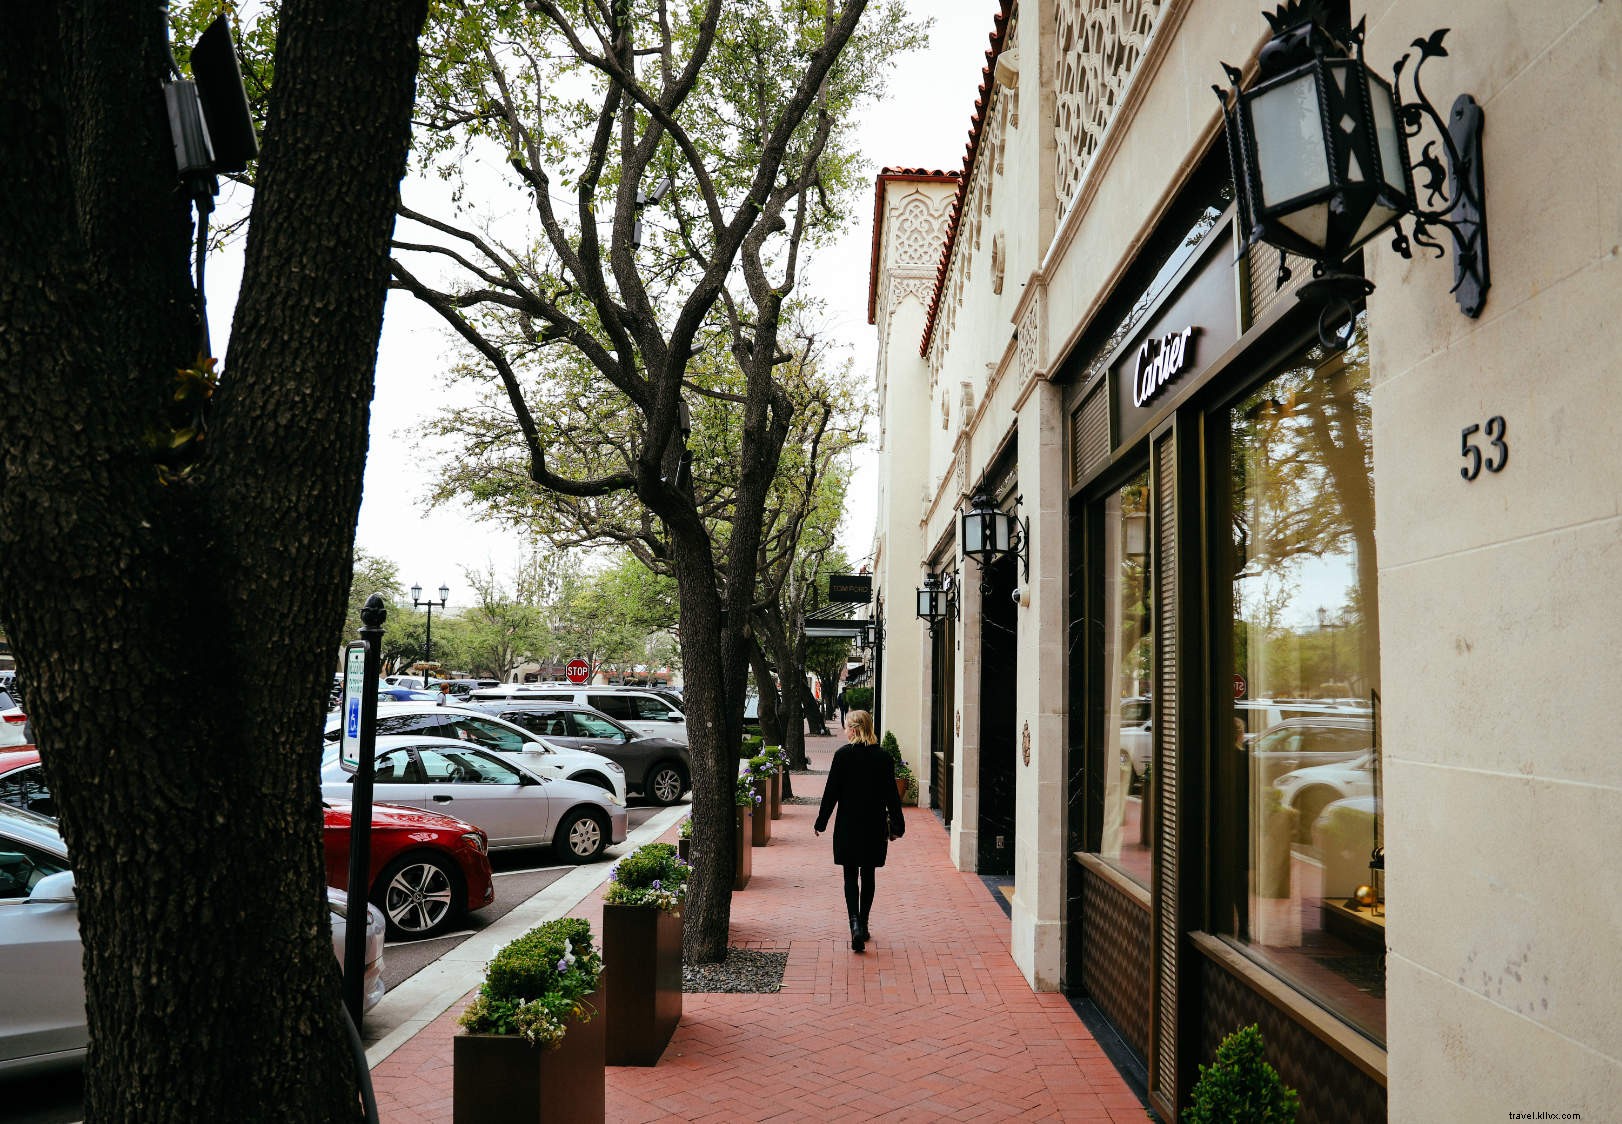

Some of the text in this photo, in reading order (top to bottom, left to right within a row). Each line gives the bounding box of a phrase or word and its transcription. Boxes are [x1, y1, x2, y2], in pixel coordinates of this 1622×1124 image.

[1134, 326, 1192, 408] Cartier
[1461, 415, 1508, 481] 53
[567, 666, 588, 676] STOP
